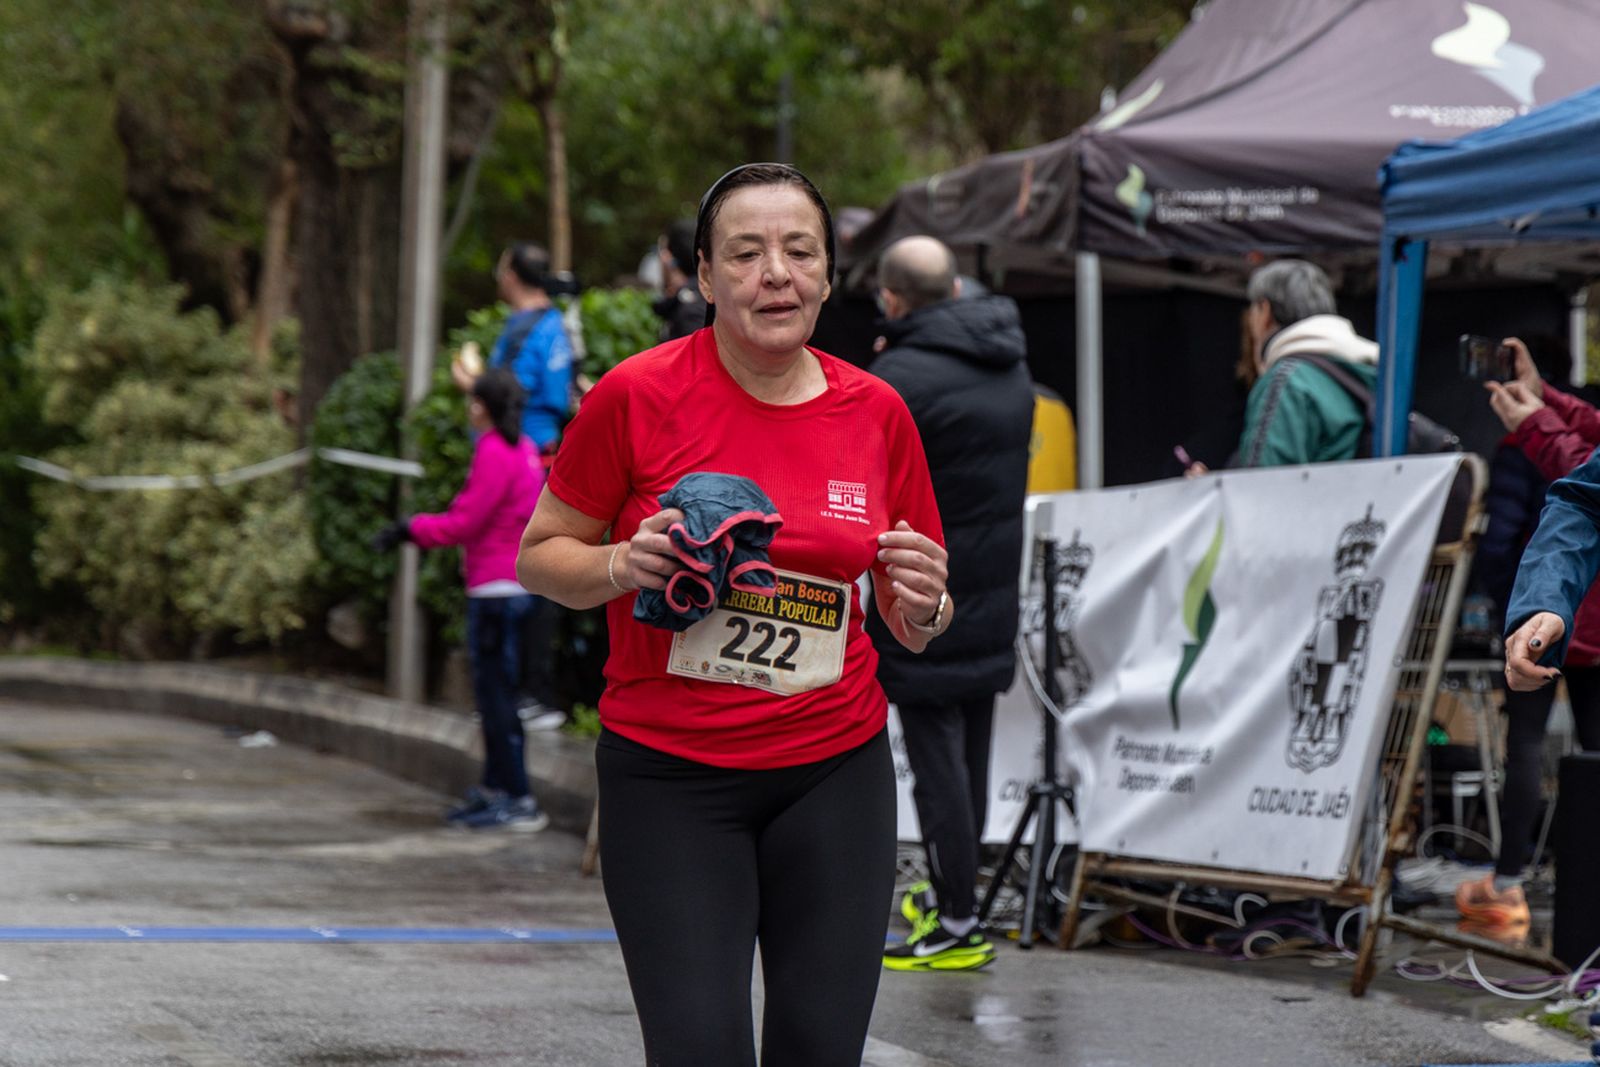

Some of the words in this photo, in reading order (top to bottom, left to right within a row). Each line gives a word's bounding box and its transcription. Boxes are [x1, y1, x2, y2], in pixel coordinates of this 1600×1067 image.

[725, 590, 775, 615] RRERA
[778, 599, 837, 627] POPULAR
[776, 582, 795, 597] an
[798, 583, 837, 604] Bosco
[719, 616, 801, 672] 222
[1249, 787, 1298, 814] CIUDAD
